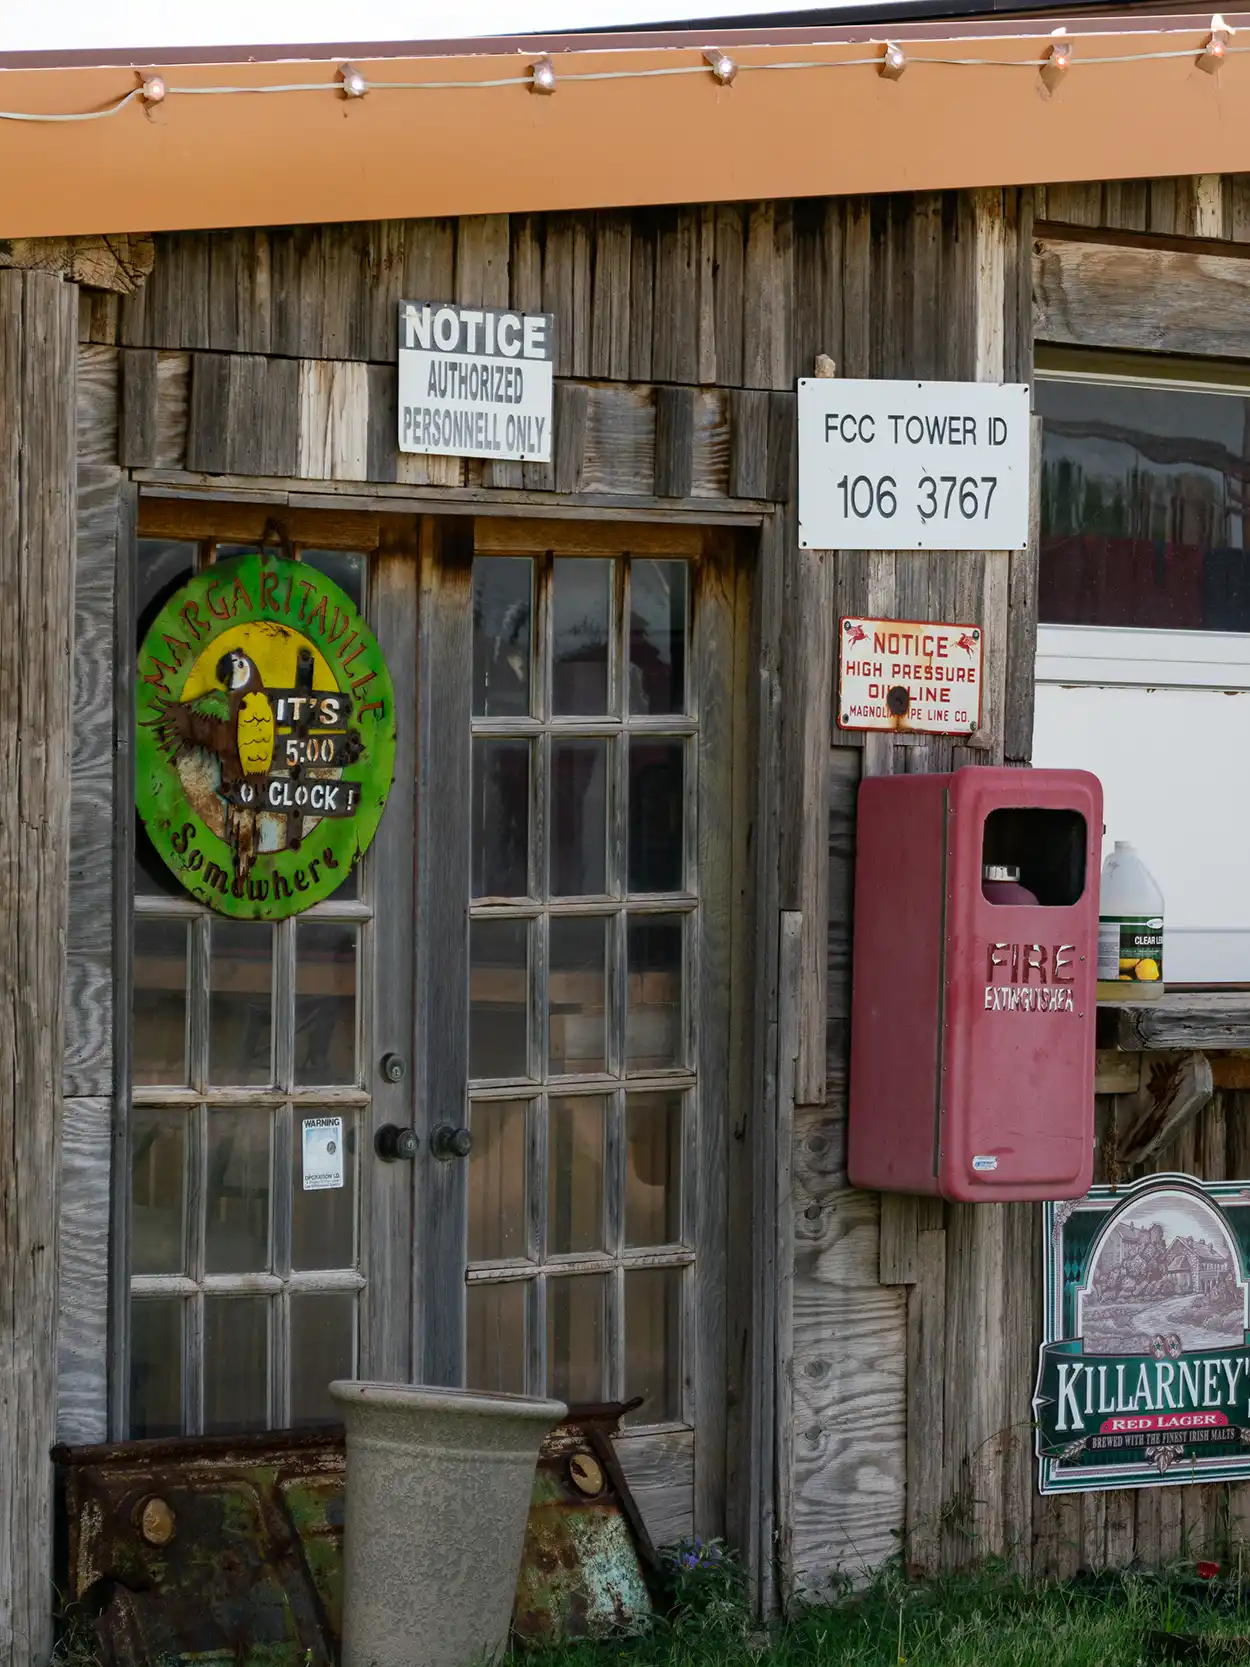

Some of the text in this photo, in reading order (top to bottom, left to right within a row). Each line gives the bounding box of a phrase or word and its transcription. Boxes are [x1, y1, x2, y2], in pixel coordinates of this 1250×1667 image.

[405, 305, 546, 359] NOTICE
[427, 360, 524, 404] AUTHORIZED
[403, 405, 546, 454] PERSONNELL ONLY
[825, 413, 1007, 446] FCC TOWER ID
[837, 475, 998, 520] 106 3767
[143, 571, 385, 725] MARGARITAVILLE
[873, 632, 949, 658] NOTICE
[846, 660, 976, 683] HIGH PRESSURE
[906, 685, 951, 703] LINE
[276, 698, 340, 725] IT'S
[928, 709, 949, 721] LINE
[955, 710, 970, 723] CO.
[285, 738, 335, 767] 5:00
[268, 781, 340, 811] CLOCK
[1134, 936, 1155, 945] CLEAR
[986, 942, 1076, 984] FIRE
[984, 986, 1074, 1013] EXTINGUISHER
[304, 1118, 340, 1127] WARNING
[1111, 1415, 1217, 1431] RED LAGER
[1092, 1428, 1235, 1448] BREWED WITH THE FINEST IRISH MALTS
